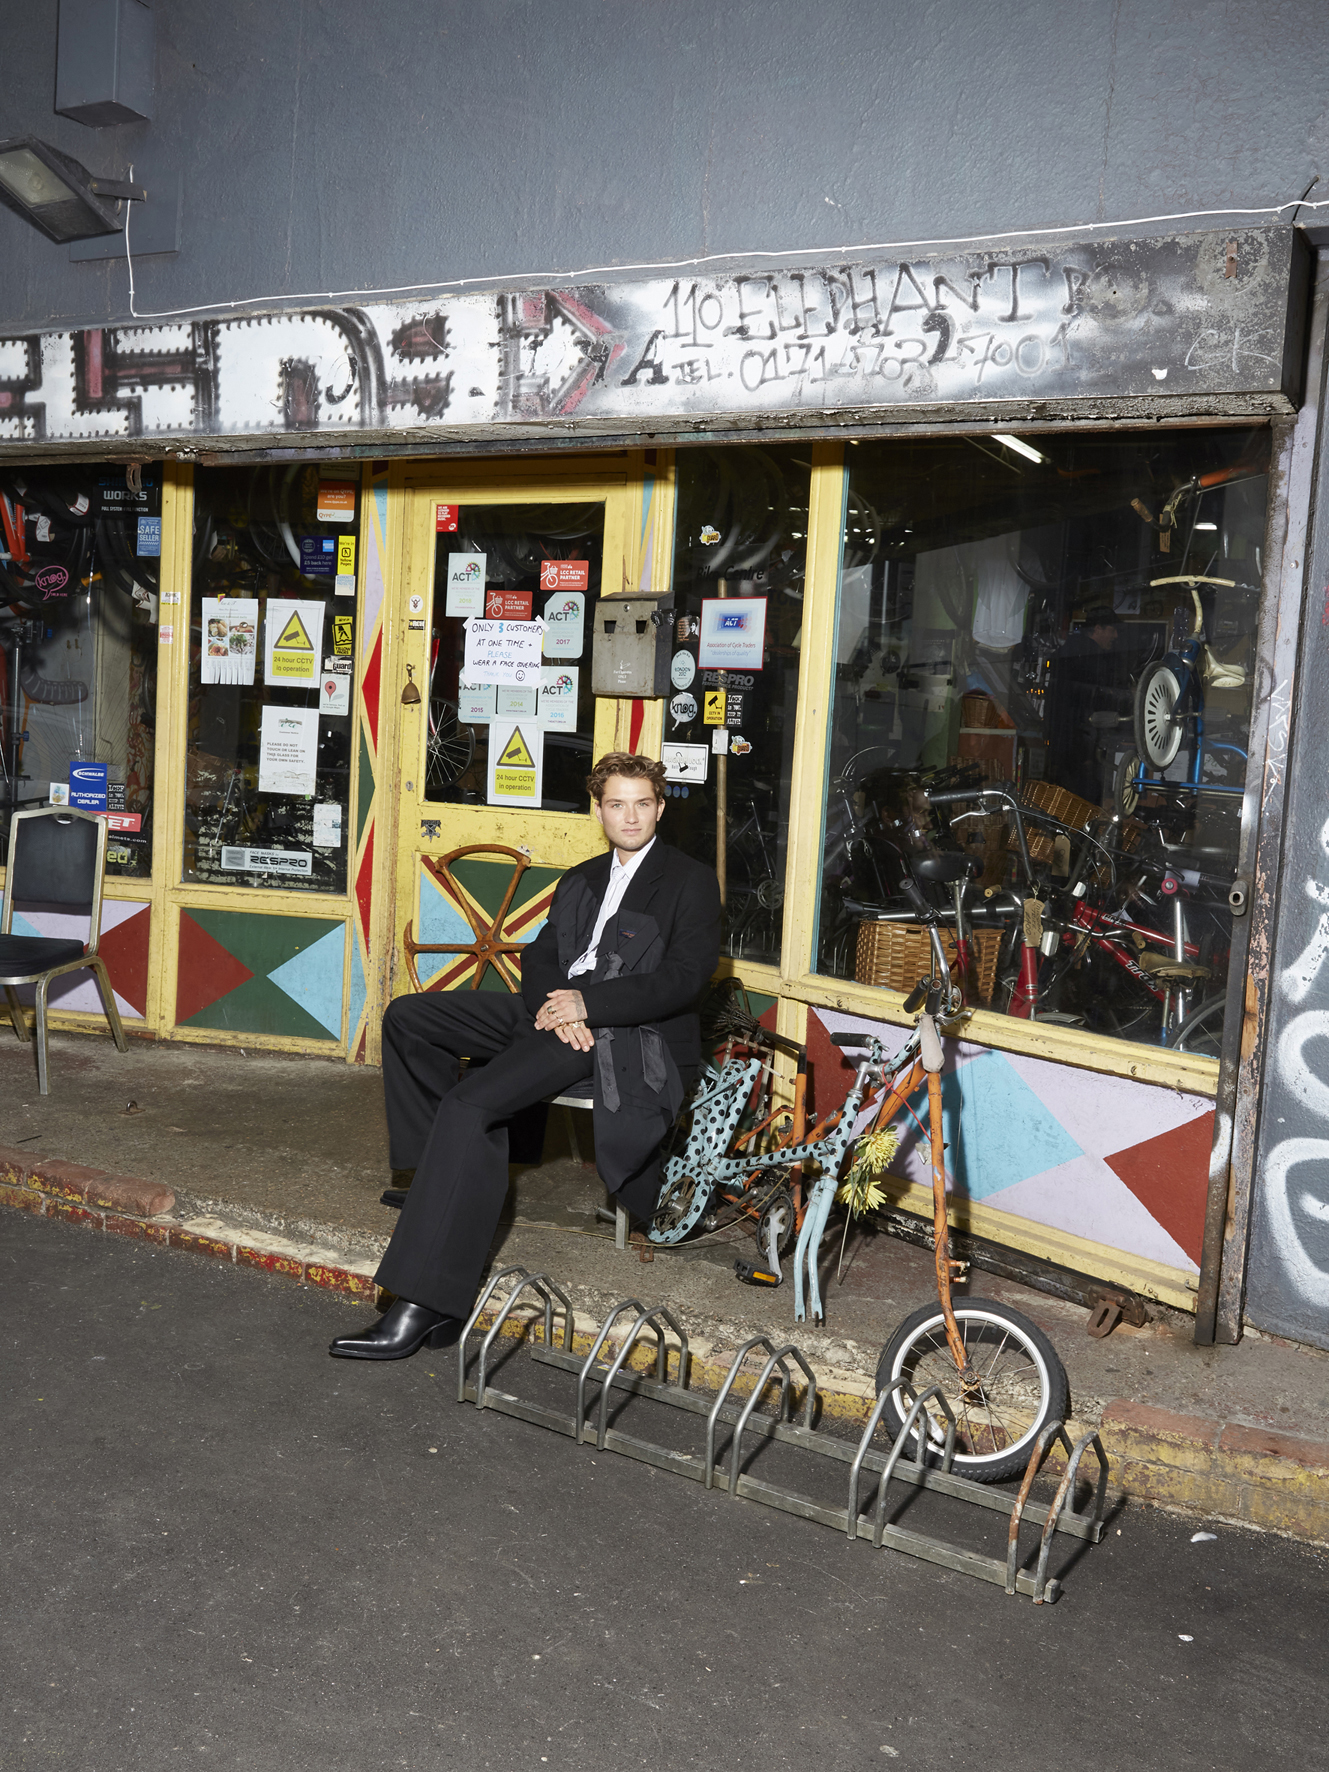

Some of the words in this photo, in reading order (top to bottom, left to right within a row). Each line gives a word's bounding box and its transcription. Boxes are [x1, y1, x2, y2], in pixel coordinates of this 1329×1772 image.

[663, 280, 723, 348] 110
[103, 490, 148, 501] WORKS
[140, 525, 160, 534] SAFE
[452, 572, 472, 581] ACT
[548, 612, 569, 621] ACT
[724, 618, 738, 626] ACT
[472, 623, 494, 633] ONLY
[499, 622, 504, 633] 3
[506, 624, 543, 635] CUSTOMERS
[476, 638, 486, 647] AT
[506, 639, 525, 648] TIME
[487, 650, 512, 658] PLEASE
[703, 671, 754, 686] RESPRO
[542, 686, 563, 695] ACT
[250, 855, 308, 867] RESPRO
